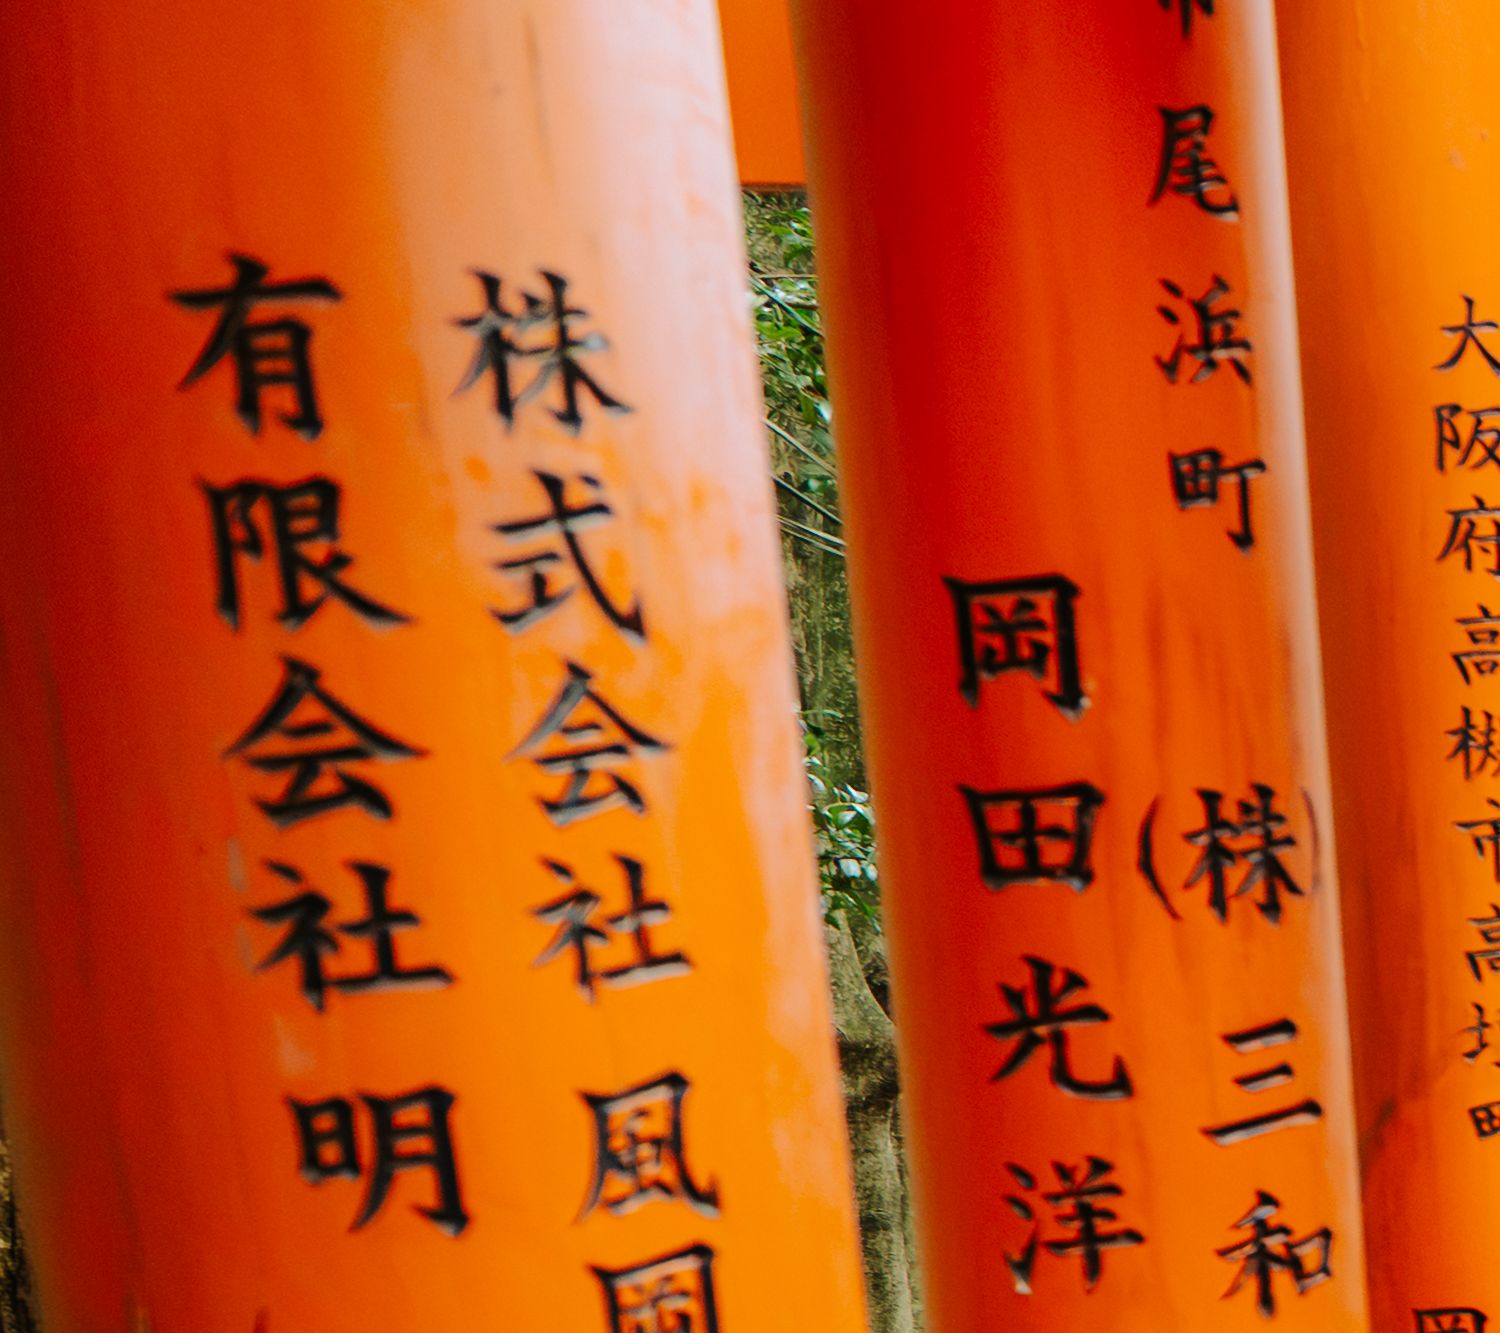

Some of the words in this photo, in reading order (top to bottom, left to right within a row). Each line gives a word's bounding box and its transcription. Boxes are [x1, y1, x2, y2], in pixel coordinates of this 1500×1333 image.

[1151, 0, 1268, 554] 尾浜町
[167, 250, 472, 1238] 有限会社明
